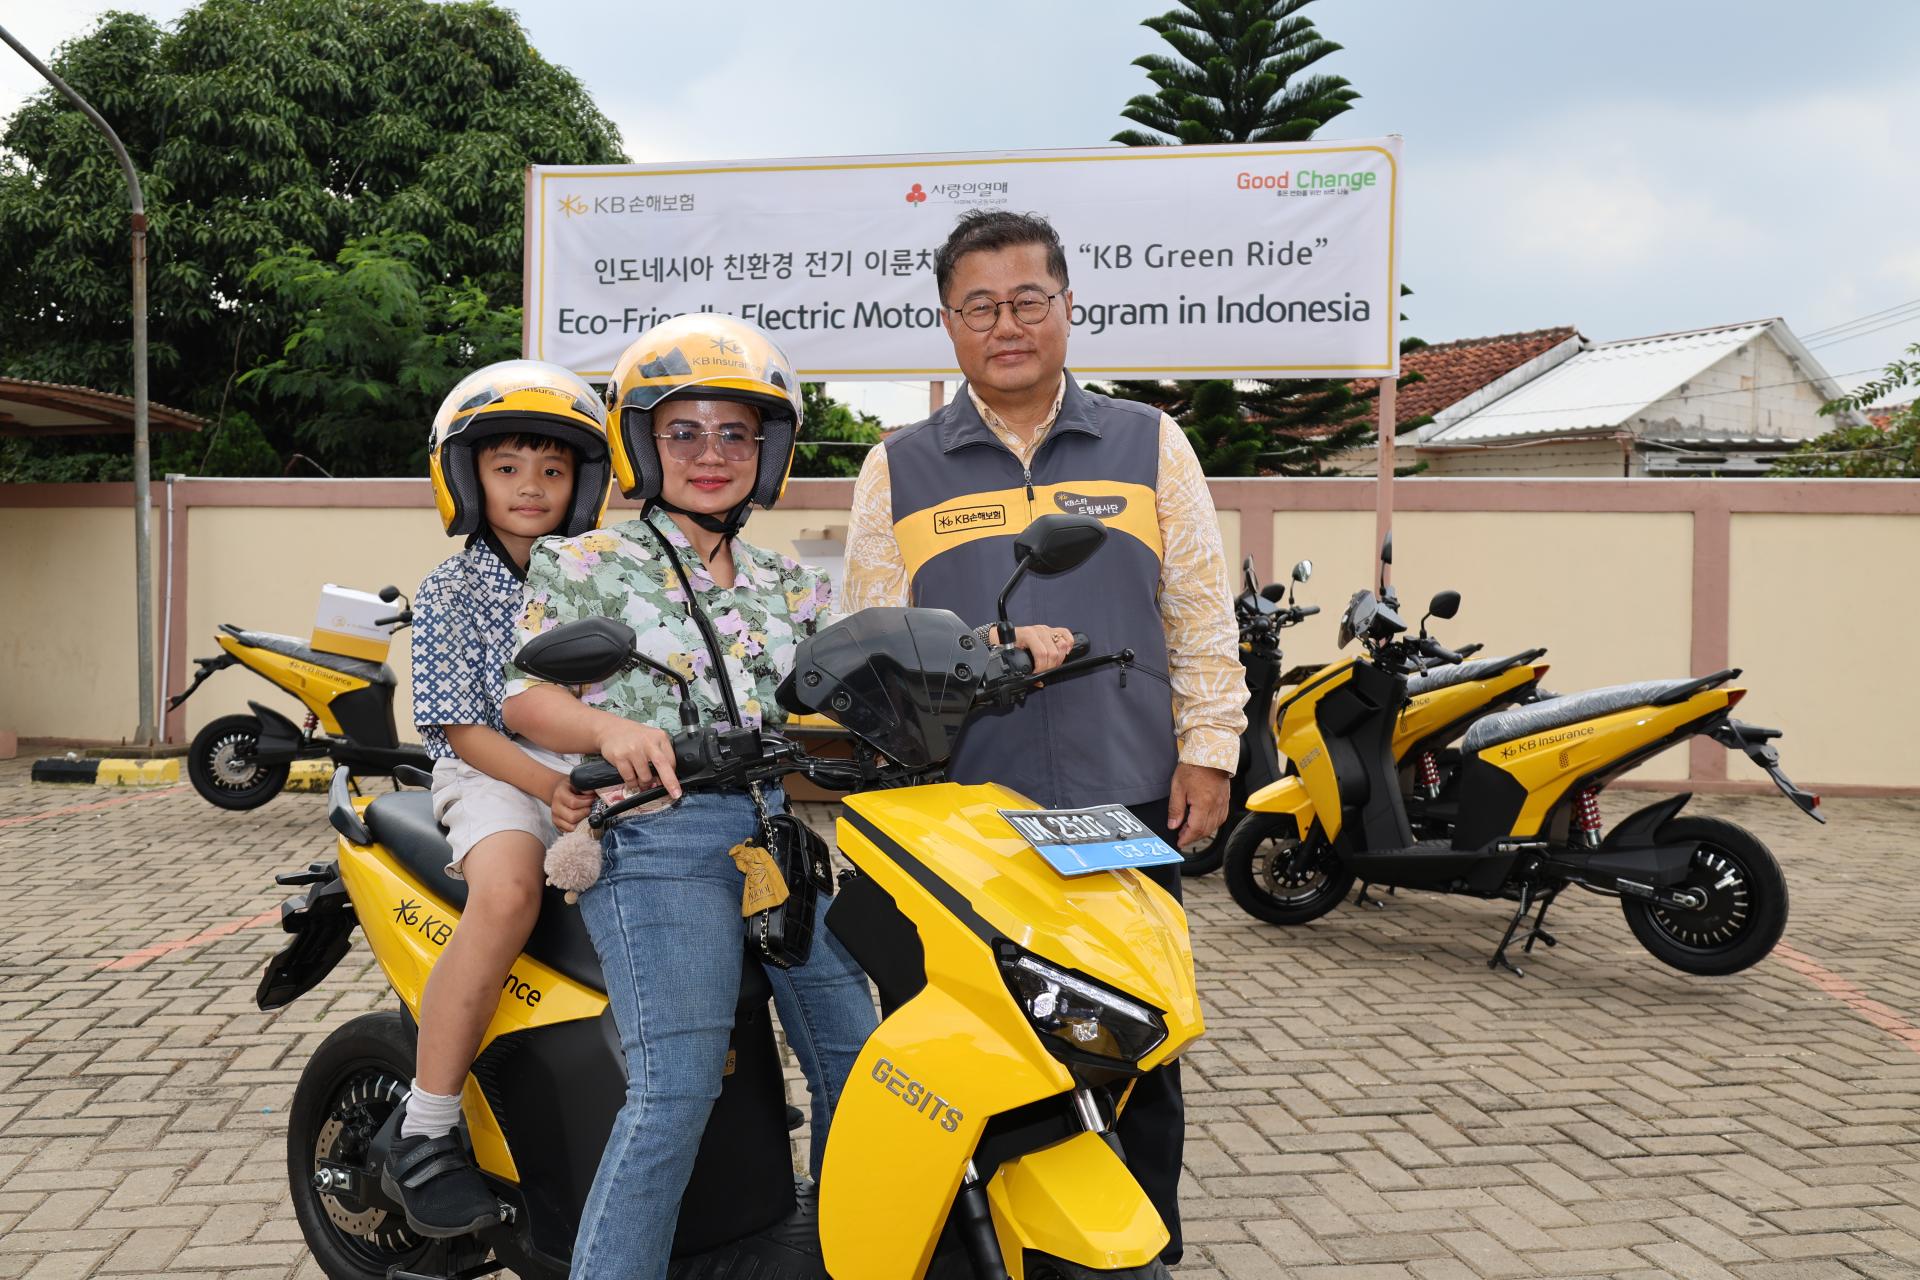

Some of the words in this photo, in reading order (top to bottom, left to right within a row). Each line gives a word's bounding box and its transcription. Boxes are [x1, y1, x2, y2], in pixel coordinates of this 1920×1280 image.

[931, 181, 1008, 199] 사랑의열매
[1236, 170, 1289, 189] Good
[1296, 169, 1377, 191] Change
[594, 193, 695, 213] KB손해보험
[594, 255, 714, 284] 인도네시아
[724, 251, 793, 280] 친환경
[805, 250, 851, 277] 전기
[1144, 243, 1233, 268] Green
[853, 301, 941, 329] Motor
[1070, 303, 1168, 335] ogram
[1179, 295, 1206, 324] in
[1217, 291, 1370, 324] Indonesia
[692, 357, 711, 366] KB
[1078, 504, 1119, 515] 드림봉사단
[1518, 740, 1537, 753] KB
[1539, 726, 1595, 747] Insurance
[1012, 815, 1060, 841] DK
[1105, 810, 1143, 834] JB
[418, 914, 453, 946] KB
[871, 1057, 964, 1133] GESITS
